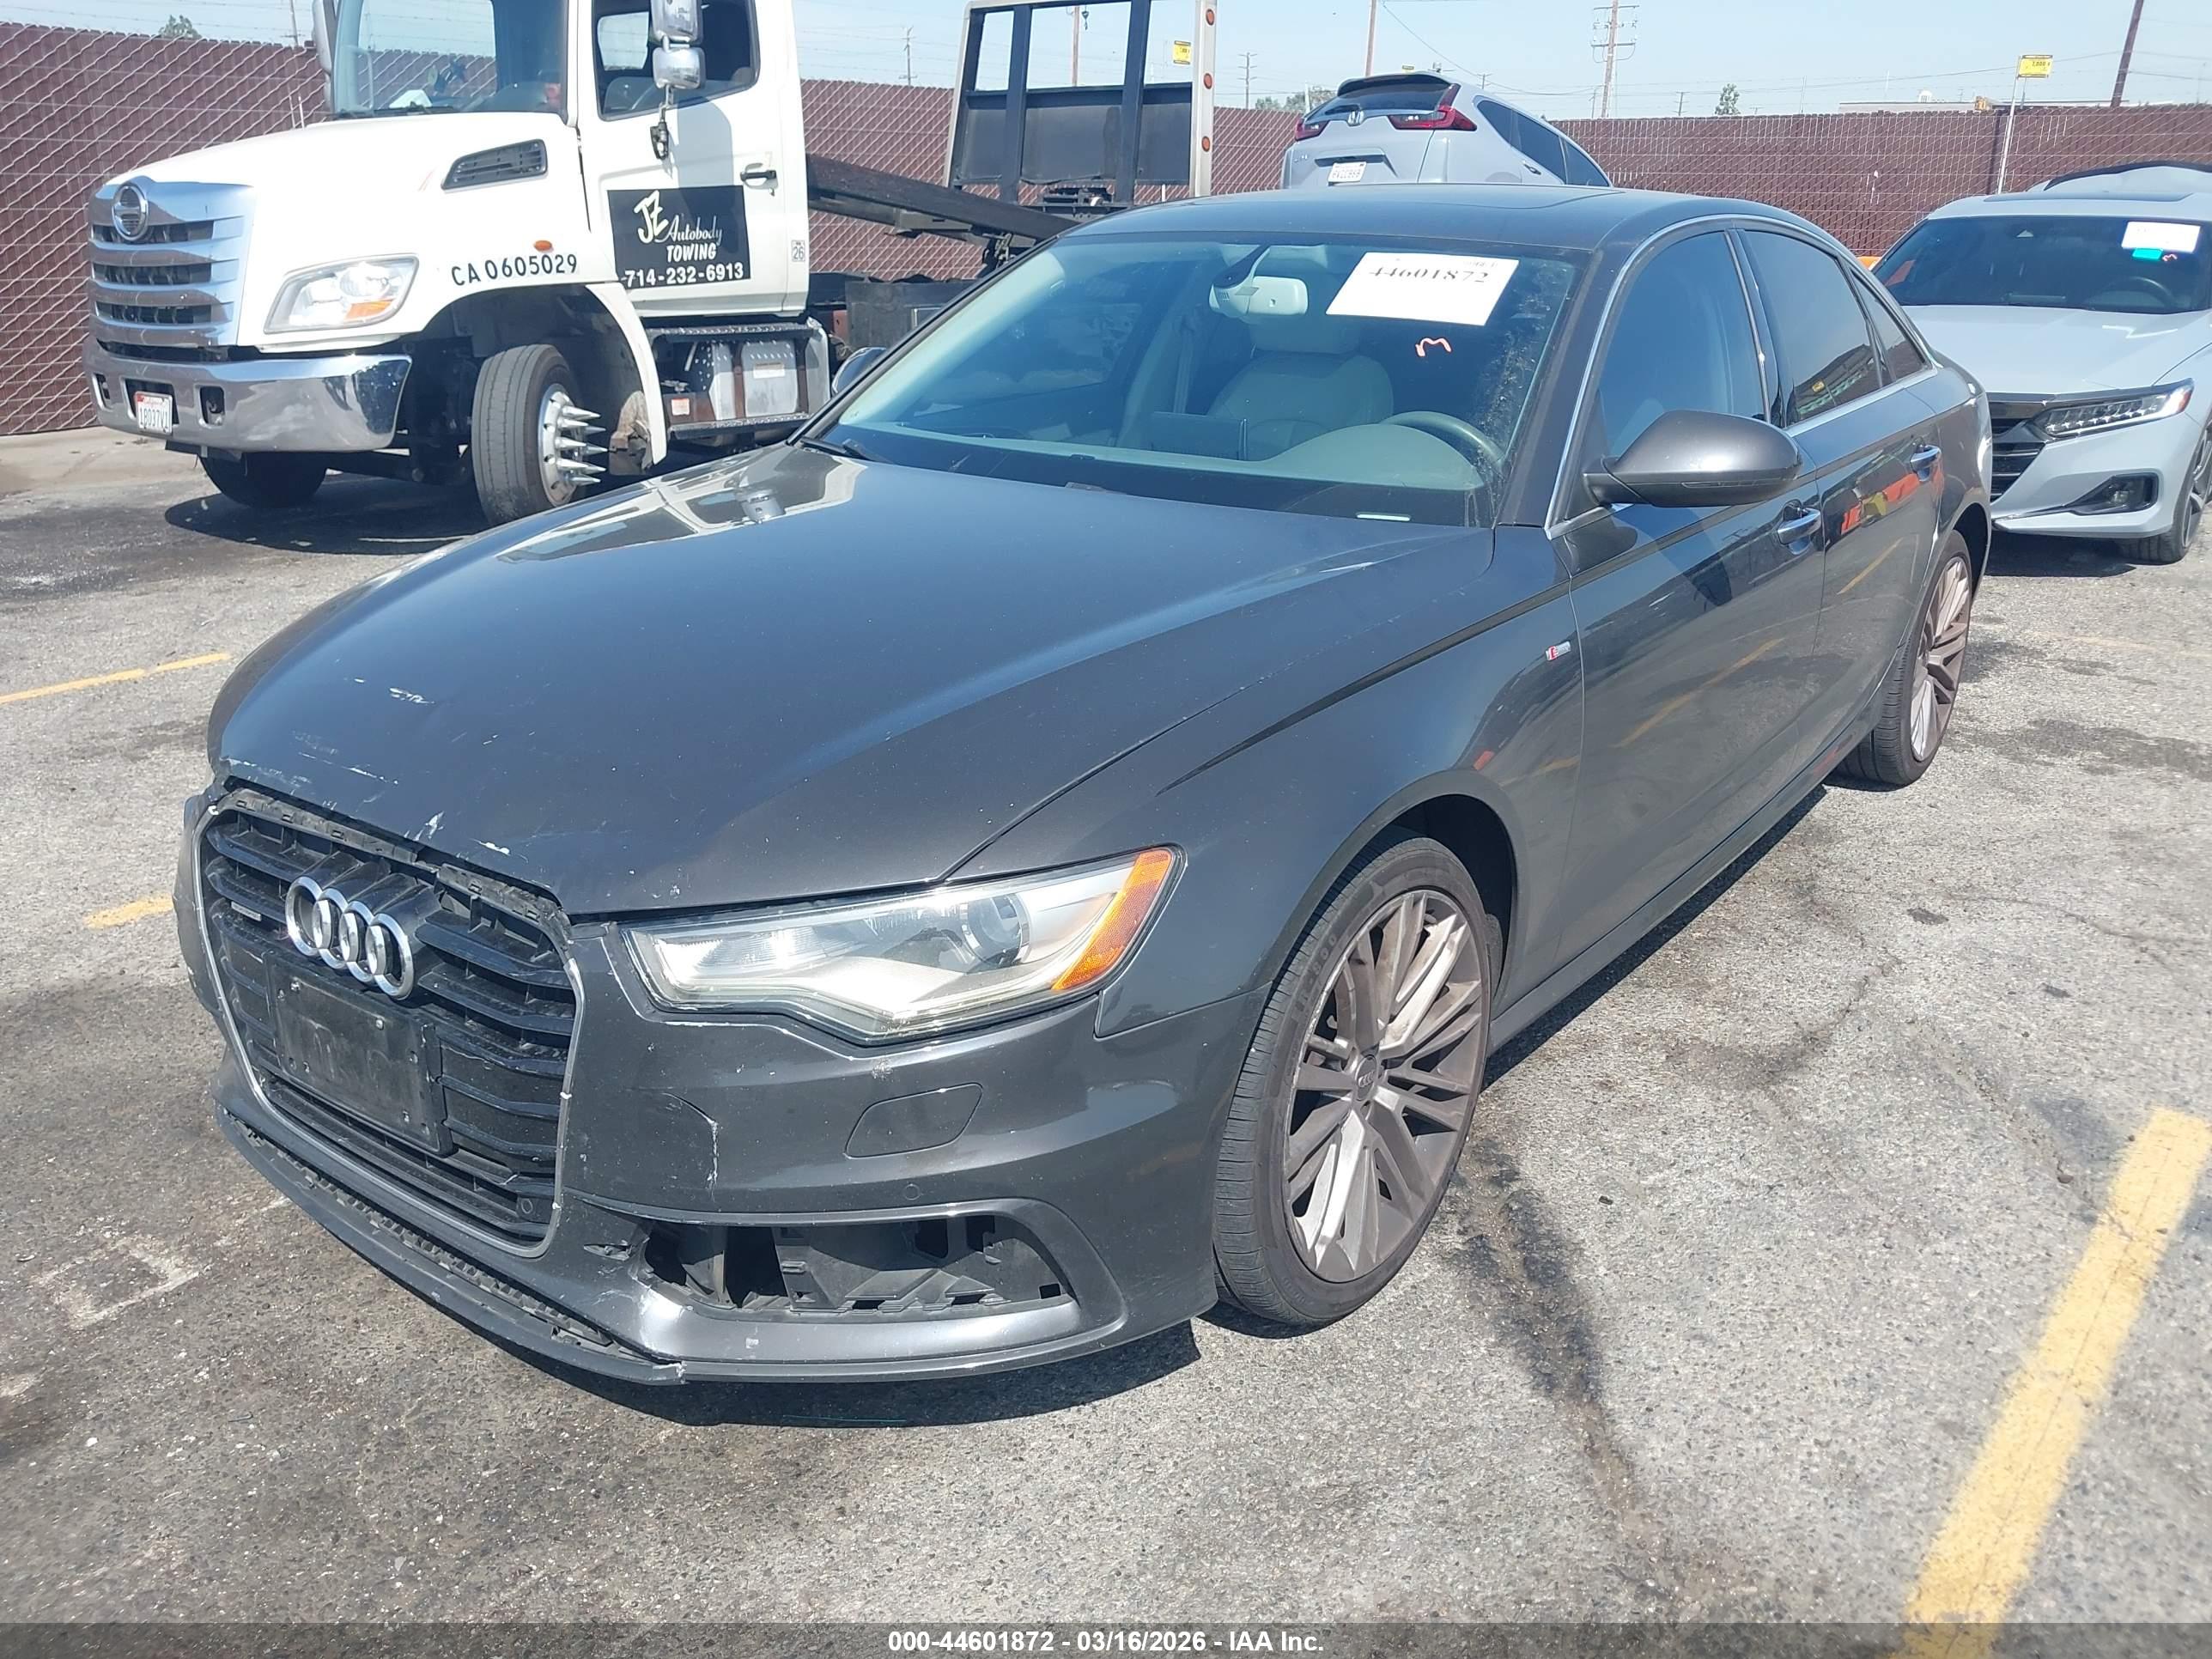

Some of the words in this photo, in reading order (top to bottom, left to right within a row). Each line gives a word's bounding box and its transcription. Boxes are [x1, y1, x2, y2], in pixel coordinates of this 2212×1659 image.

[654, 215, 723, 246] Autobody
[666, 242, 717, 263] TOWING
[624, 262, 744, 288] 714-232-6913
[1369, 266, 1489, 283] 44601872
